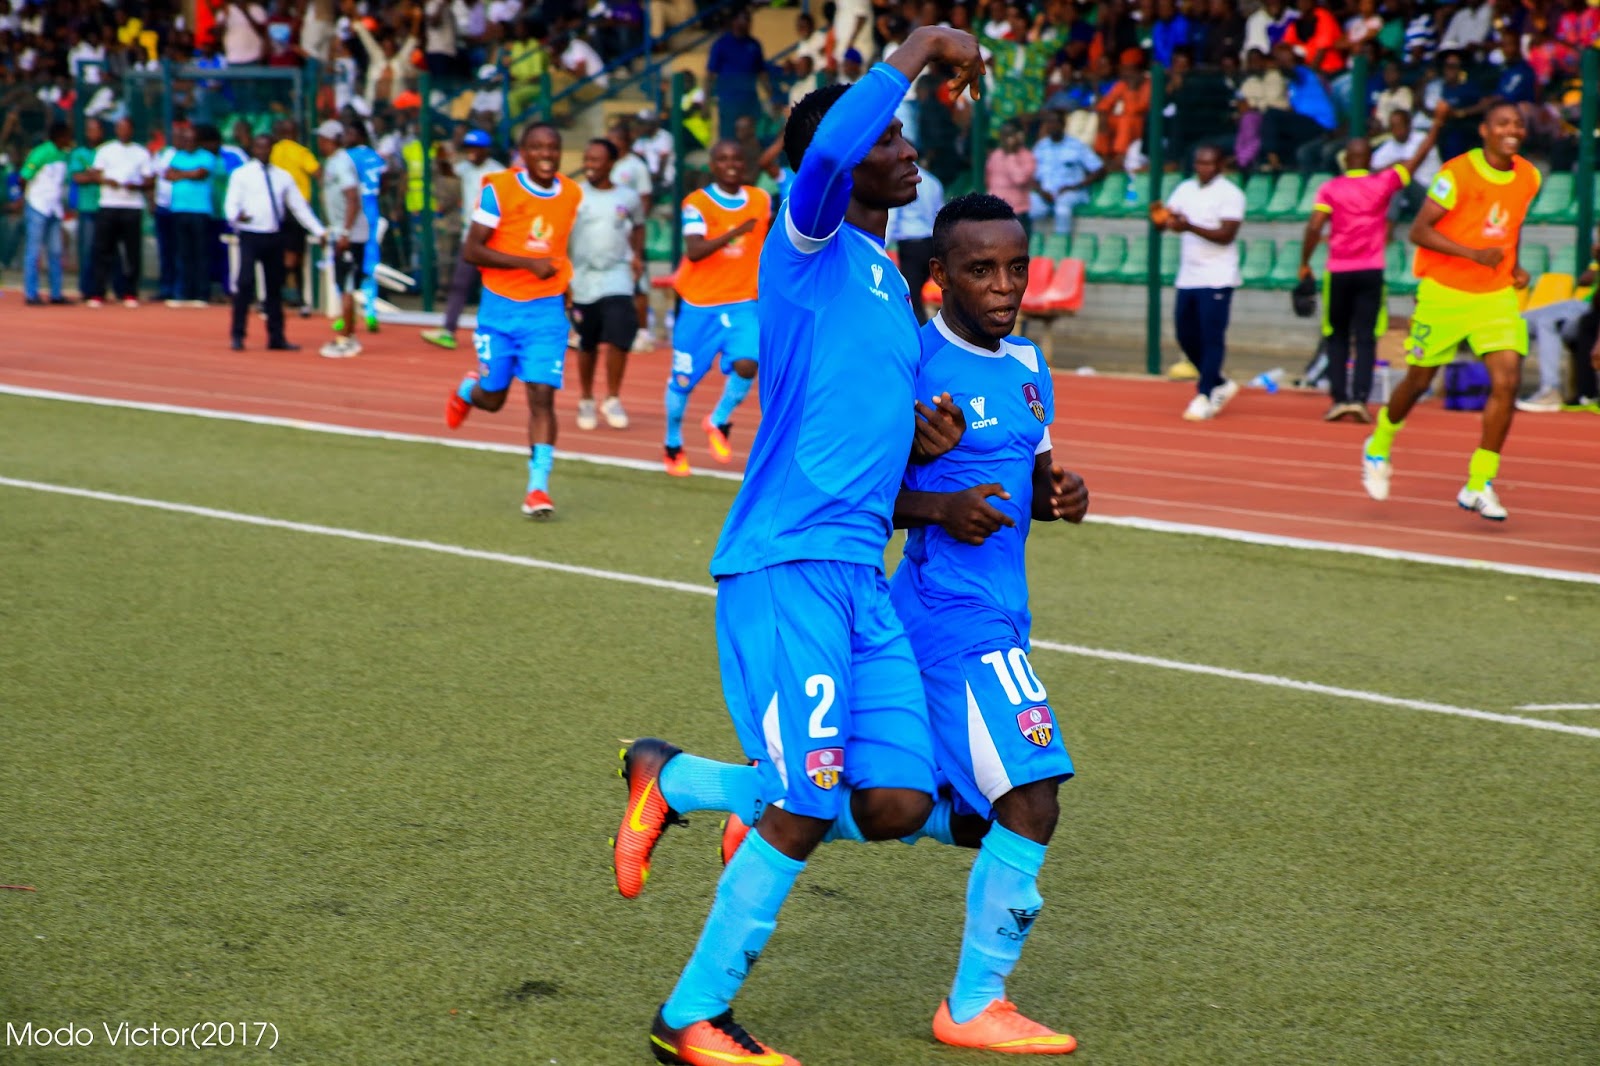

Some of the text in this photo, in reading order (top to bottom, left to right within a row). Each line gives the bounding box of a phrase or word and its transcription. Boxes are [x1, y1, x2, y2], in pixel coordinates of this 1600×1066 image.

[971, 417, 999, 430] cone
[804, 673, 839, 739] 2
[981, 647, 1047, 706] 10
